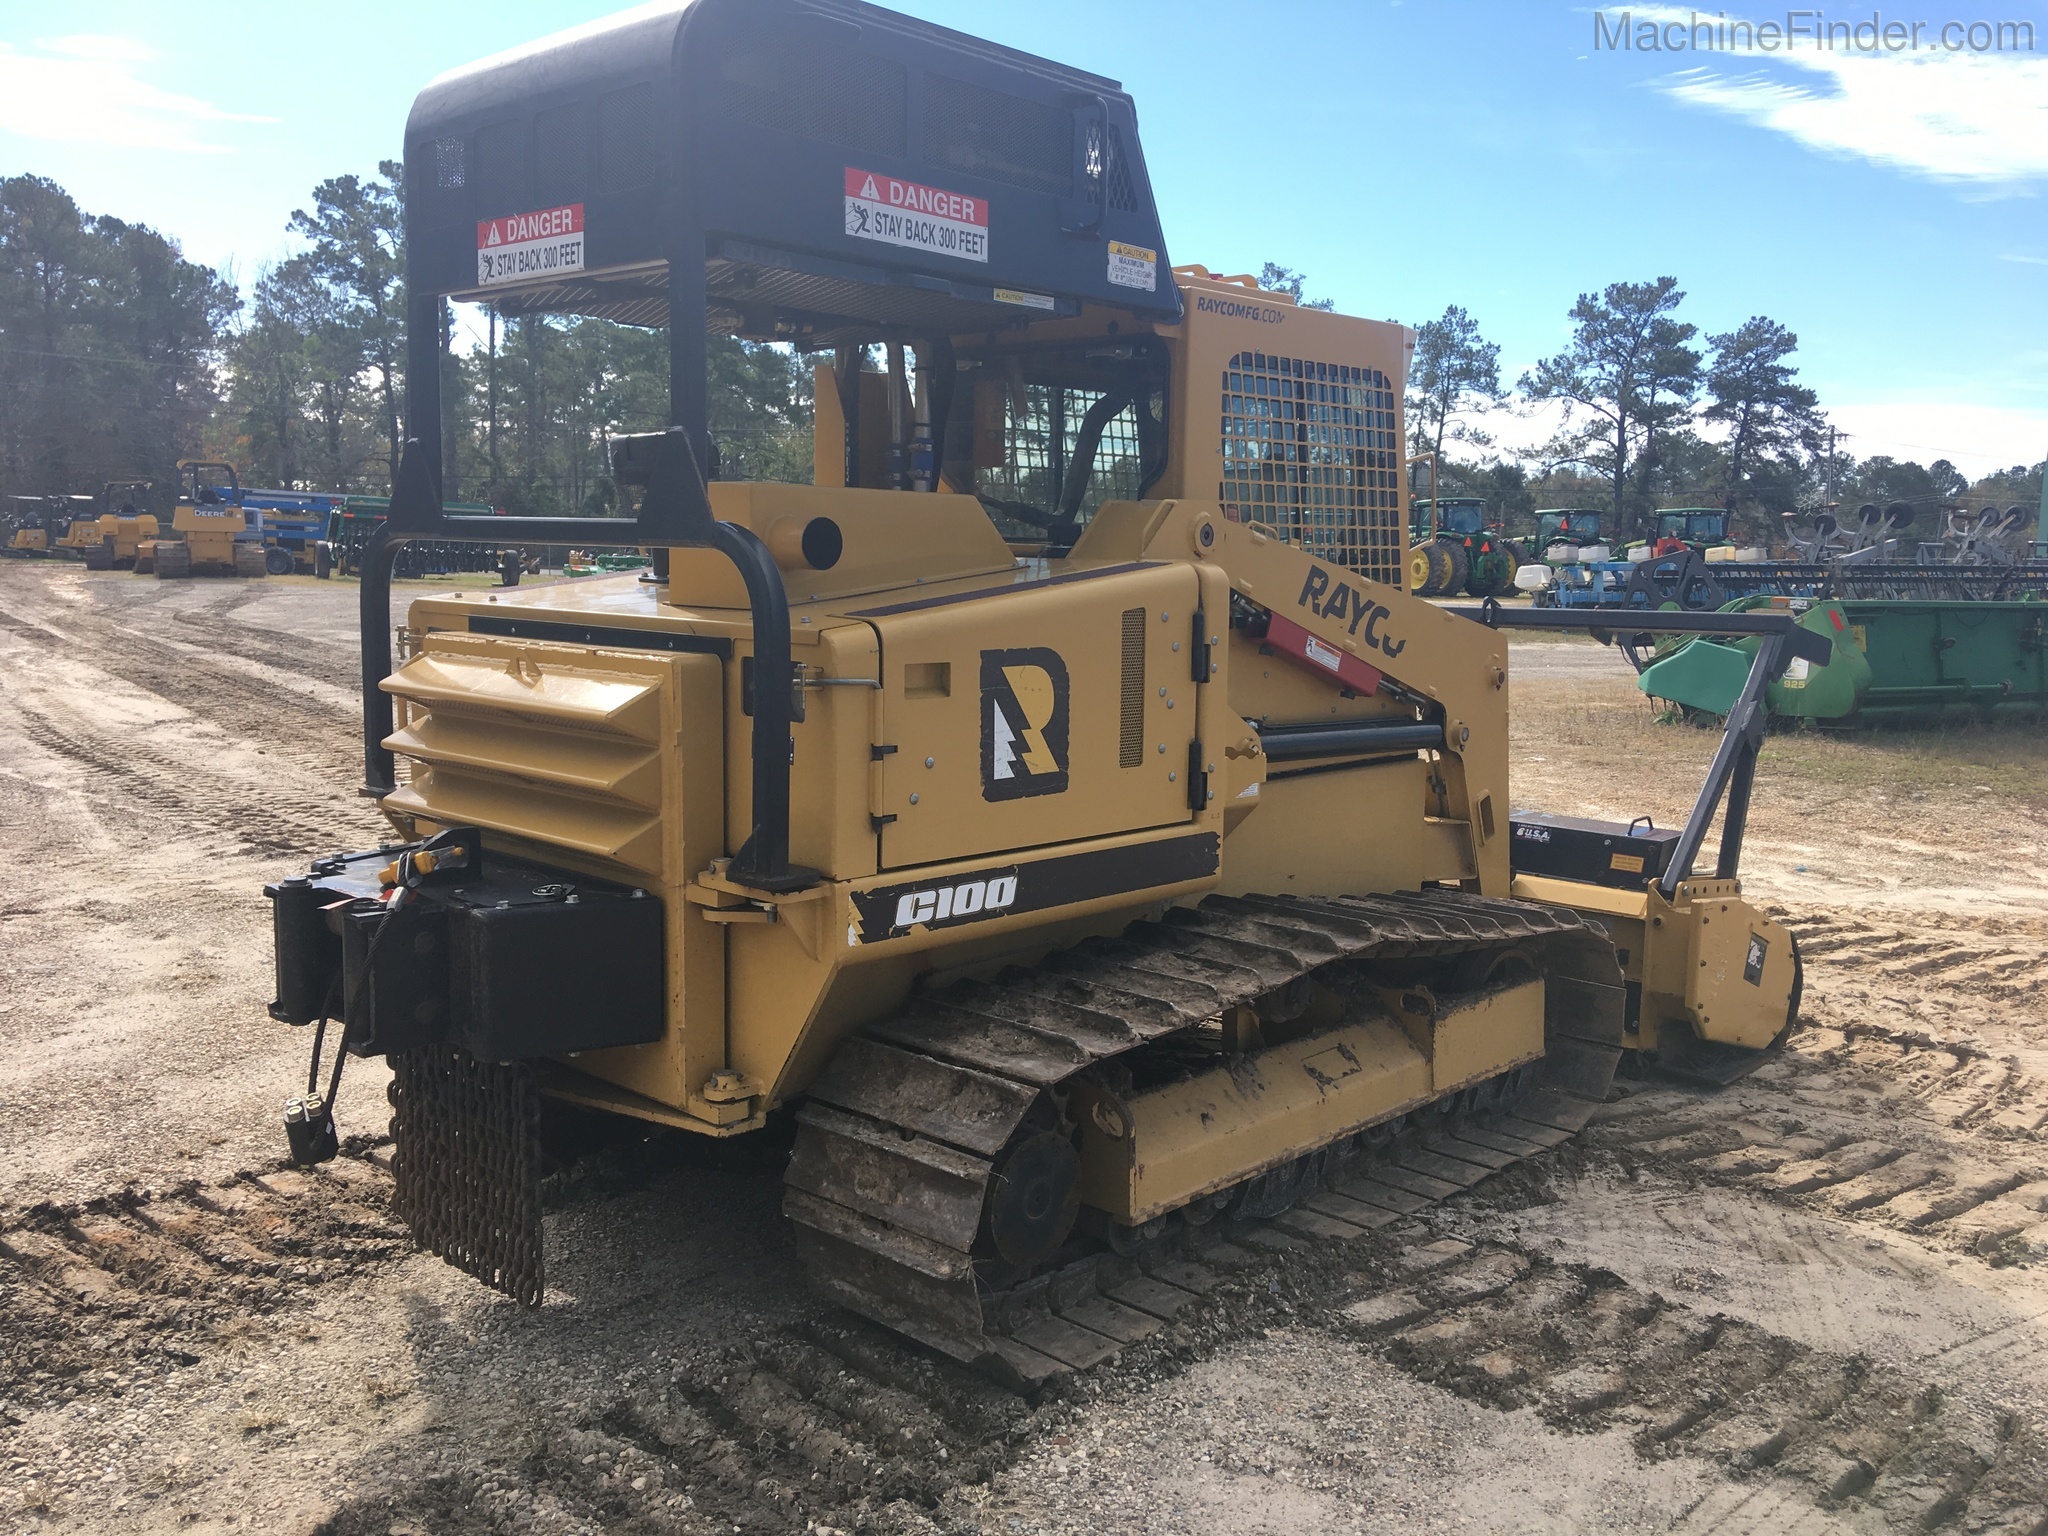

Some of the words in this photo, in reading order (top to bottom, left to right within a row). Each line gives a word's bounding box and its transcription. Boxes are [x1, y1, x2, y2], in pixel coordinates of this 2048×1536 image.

[889, 180, 975, 222] DANGER
[507, 208, 573, 242] DANGER
[874, 211, 903, 238] STAY
[905, 218, 937, 246] BACK
[938, 226, 957, 250] 300
[958, 229, 986, 256] FEET
[497, 252, 518, 277] STAY
[518, 247, 542, 273] BACK
[543, 245, 558, 270] 300
[559, 241, 582, 267] FEET
[1123, 246, 1149, 260] CAUTION
[1001, 292, 1024, 302] CAUTION
[194, 509, 226, 518] DEERE
[1783, 680, 1806, 689] 925
[1524, 828, 1551, 839] U.S.A.
[895, 875, 1018, 927] C100
